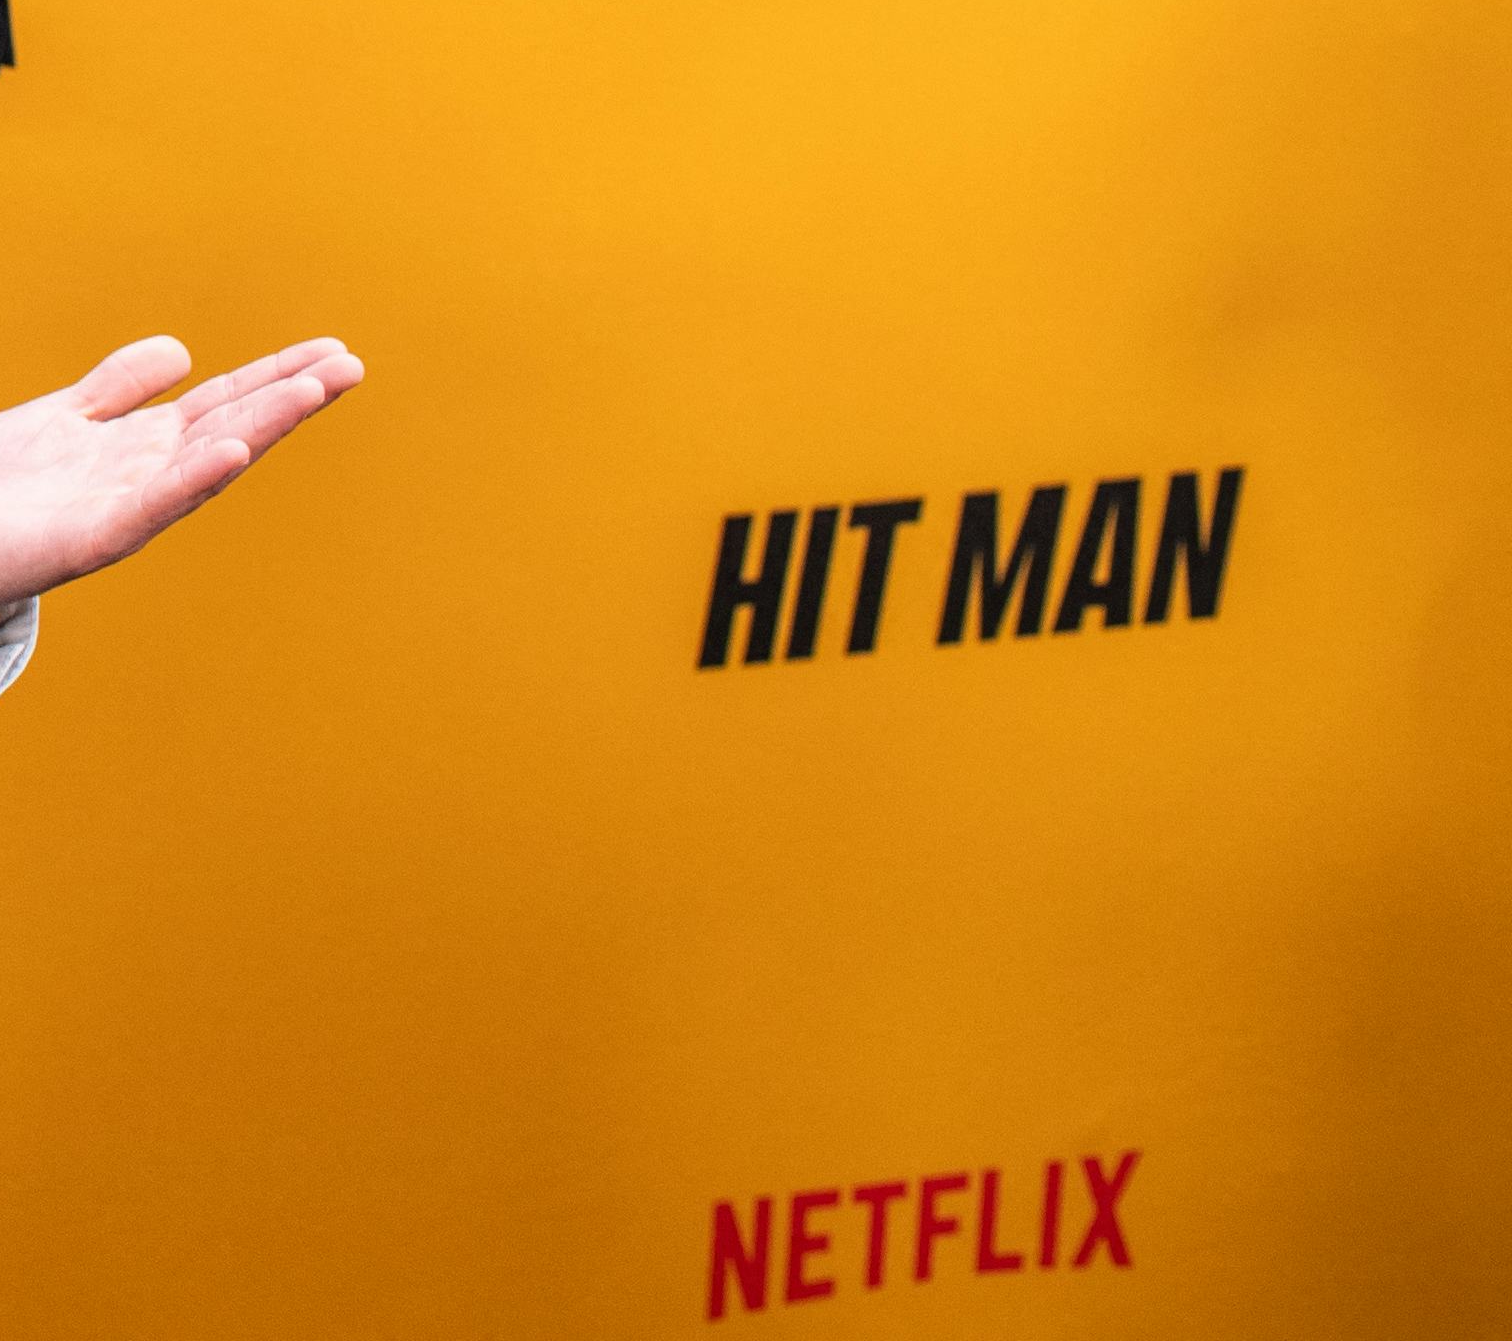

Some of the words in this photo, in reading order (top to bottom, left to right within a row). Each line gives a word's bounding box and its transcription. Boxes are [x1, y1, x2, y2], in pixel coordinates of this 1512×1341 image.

[695, 497, 925, 671] HIT
[934, 465, 1245, 648] MAN
[704, 1150, 1142, 1322] NETFLIX
